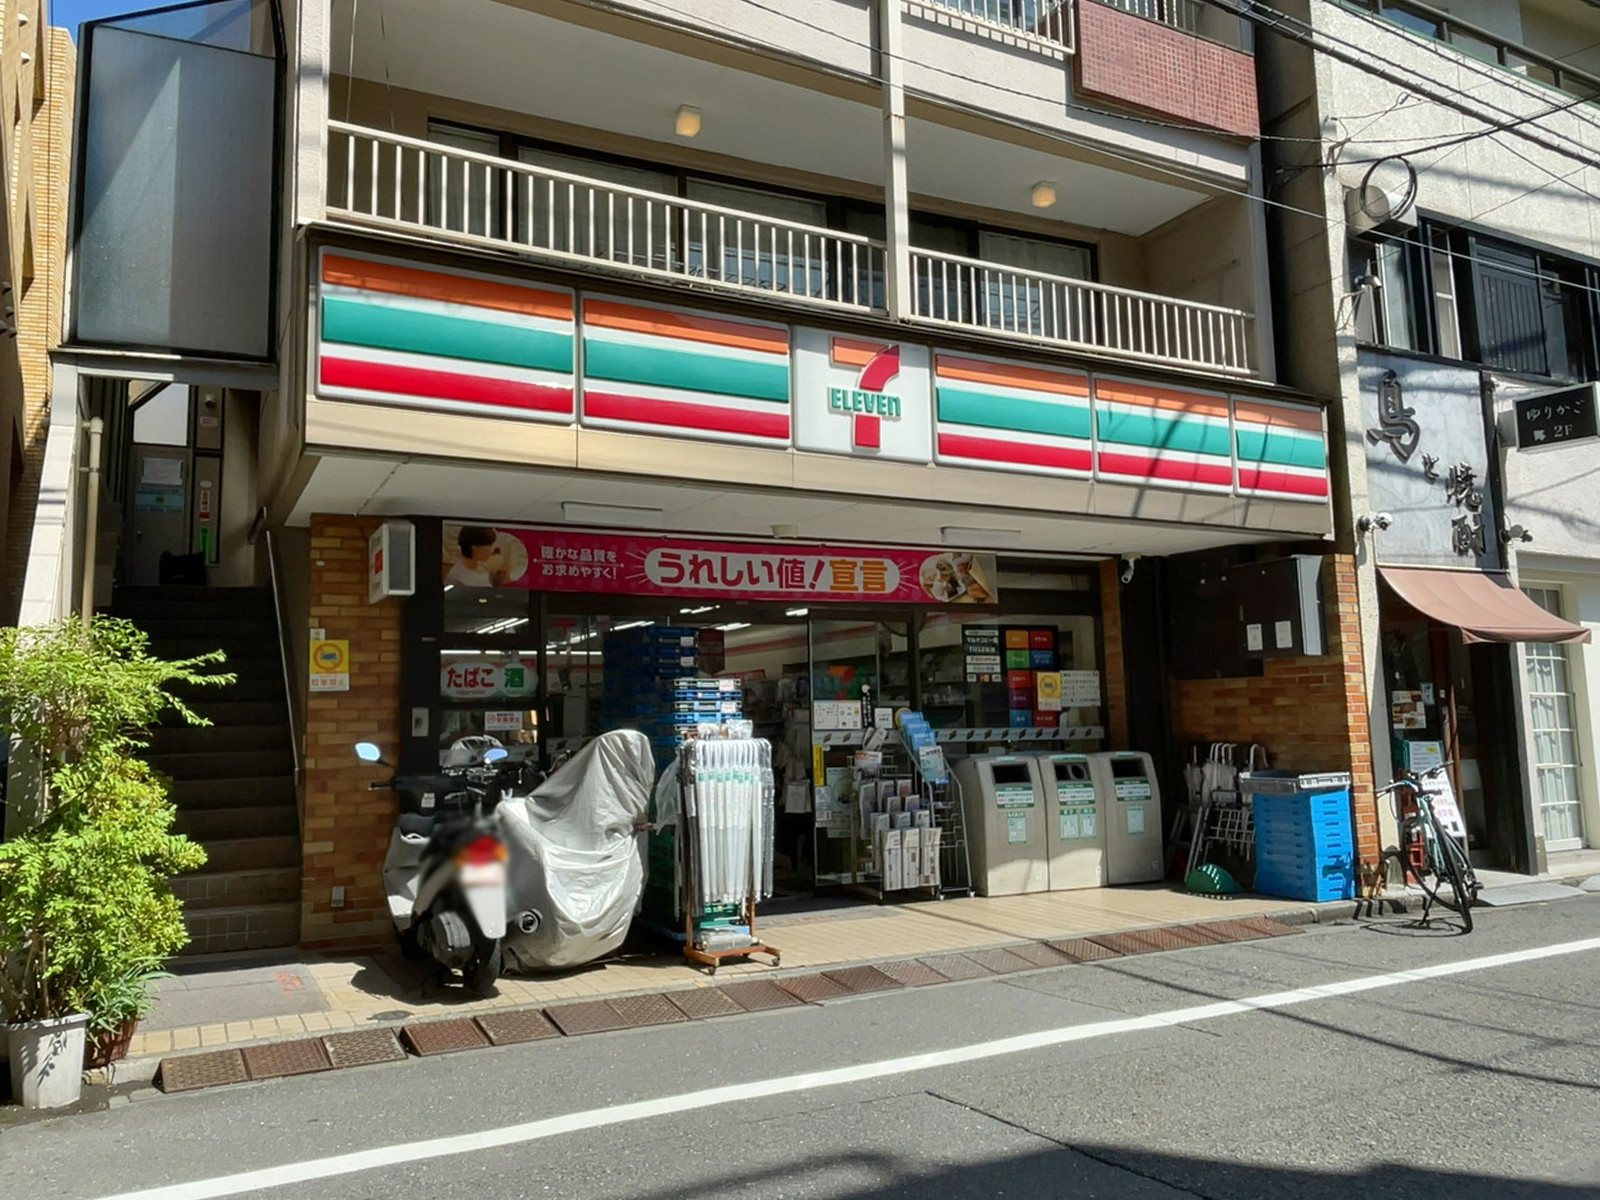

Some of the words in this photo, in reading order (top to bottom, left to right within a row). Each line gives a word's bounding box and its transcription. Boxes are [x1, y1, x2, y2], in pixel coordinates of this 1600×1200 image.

[1526, 399, 1585, 421] ゆりかご
[1553, 424, 1573, 438] 2F
[541, 546, 616, 562] 確かな品質を
[447, 667, 495, 688] たばこ
[504, 668, 525, 688] 酒
